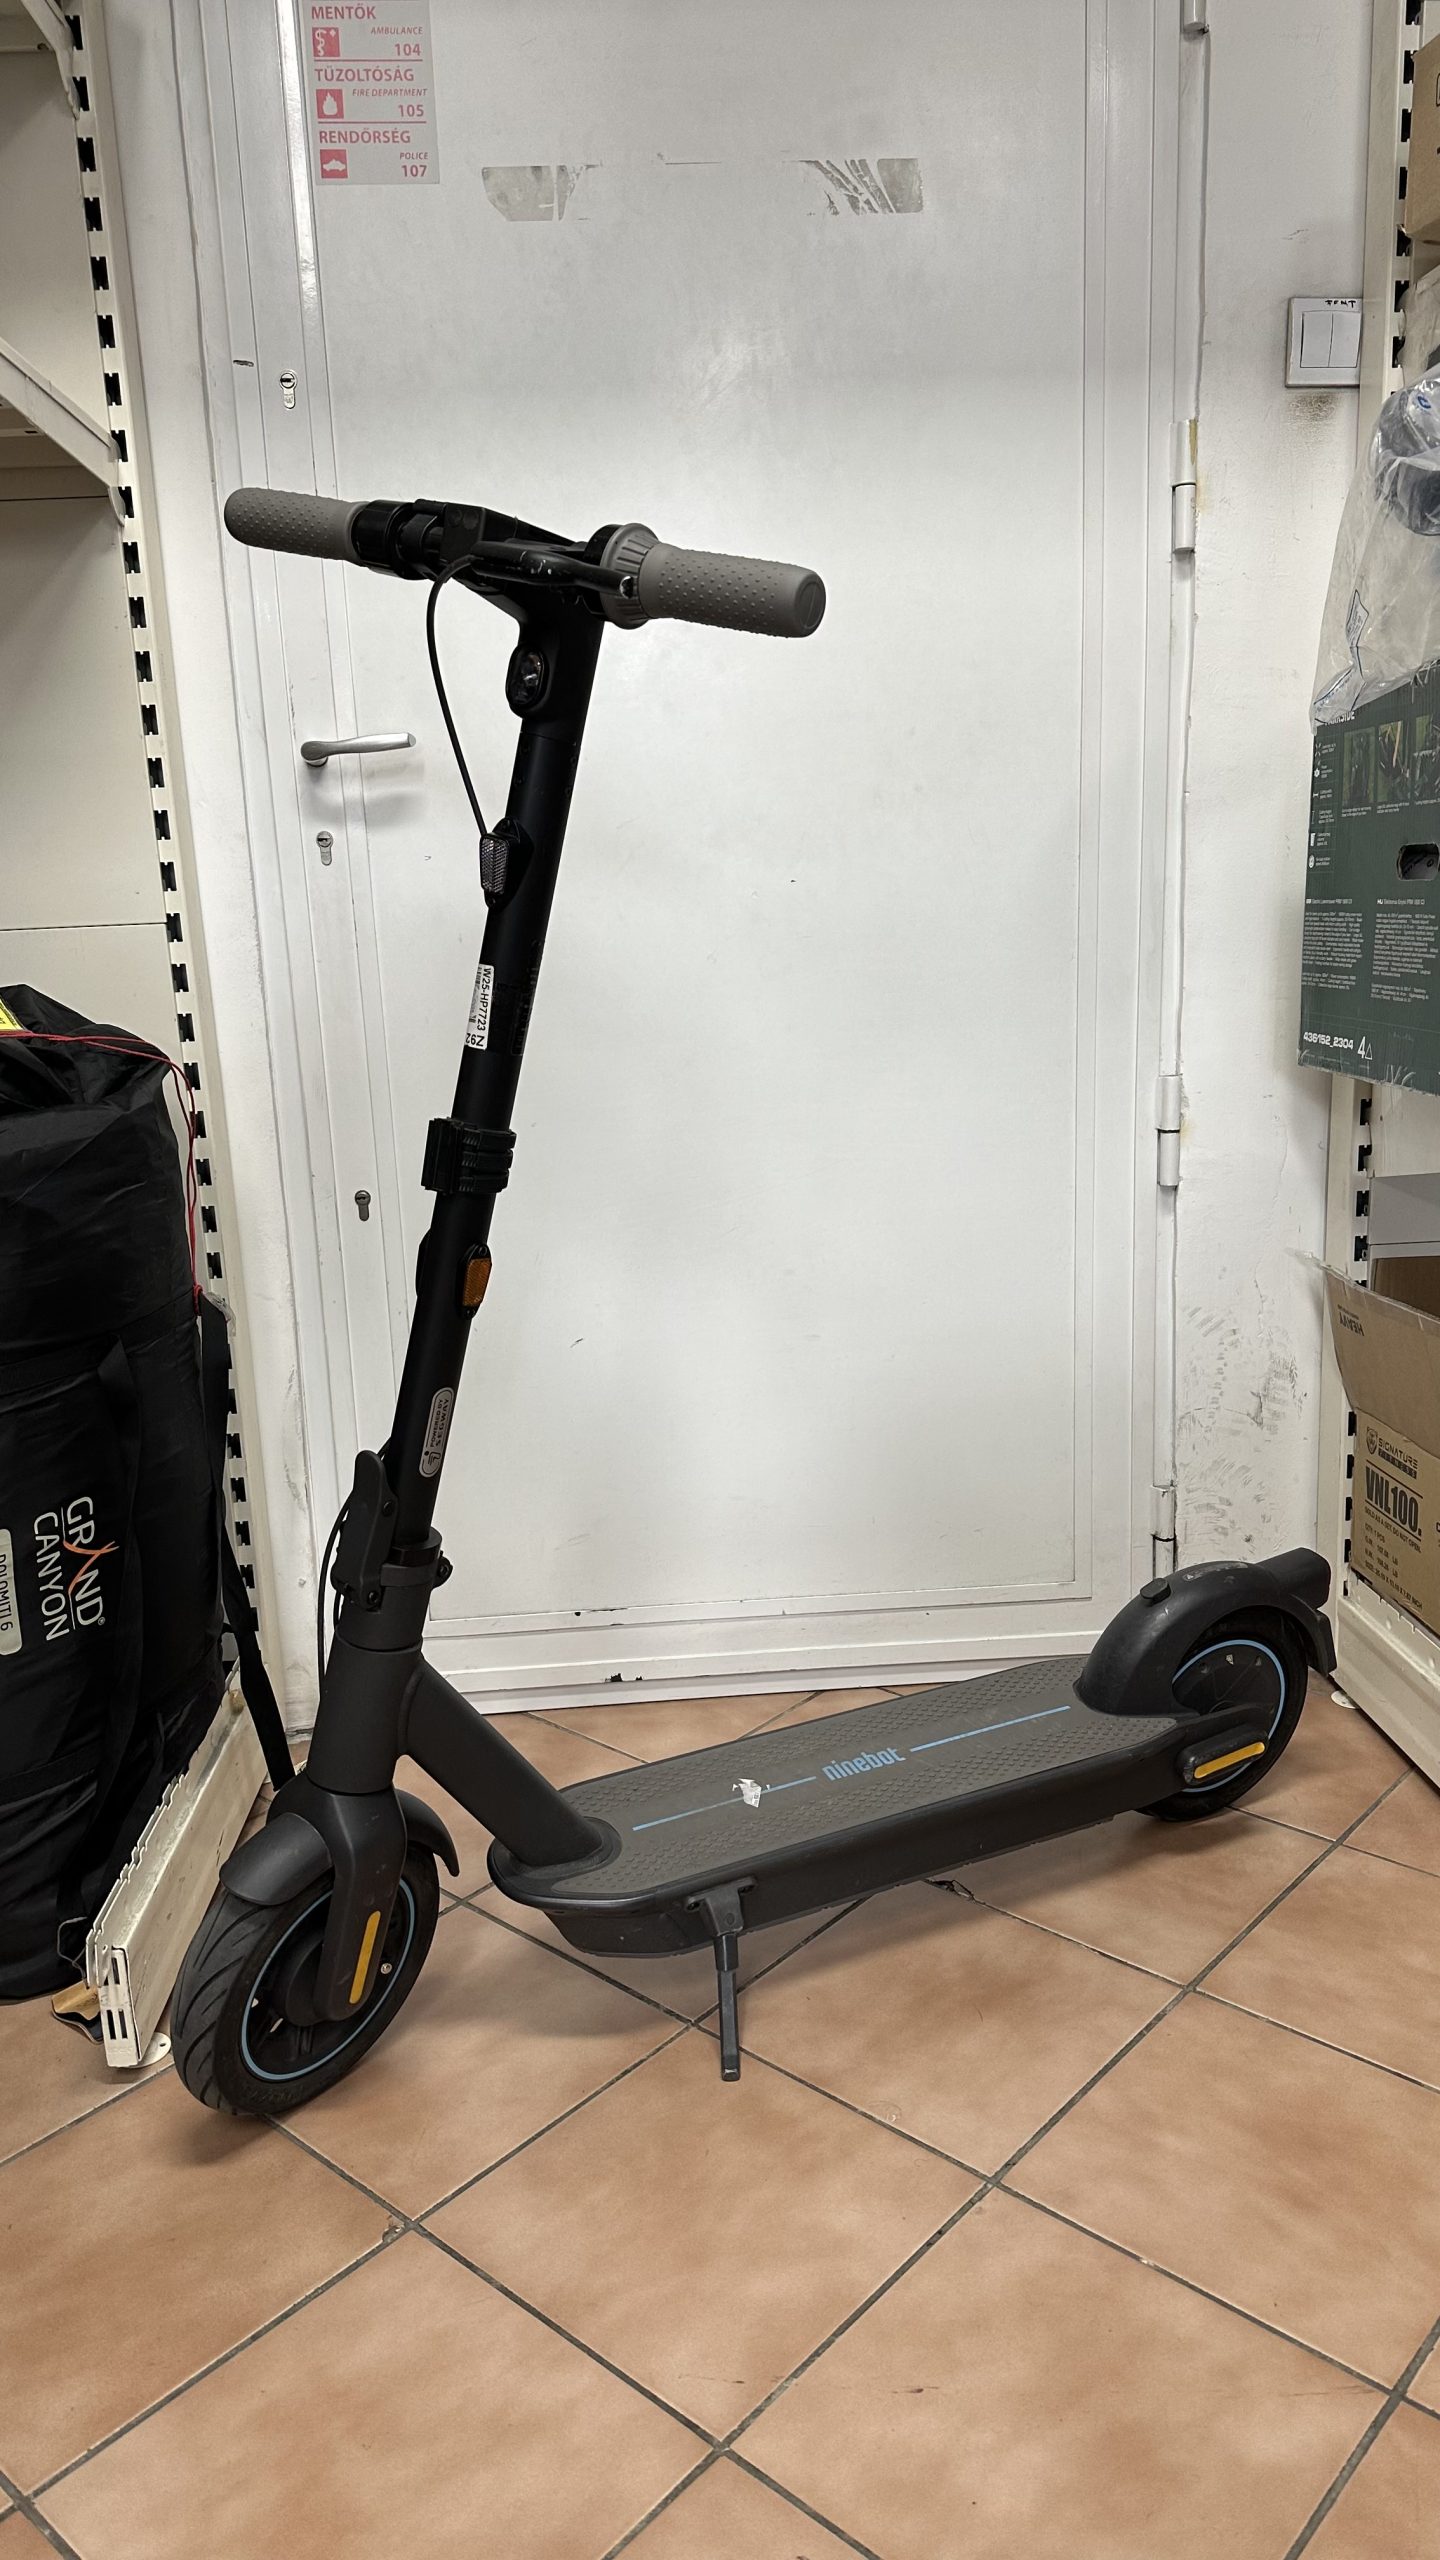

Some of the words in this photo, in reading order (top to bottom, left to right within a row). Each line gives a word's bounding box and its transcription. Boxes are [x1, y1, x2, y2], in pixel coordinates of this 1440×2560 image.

[312, 3, 376, 20] MENTŐK
[370, 27, 423, 35] AMBULANCE
[394, 43, 421, 56] 104
[314, 65, 414, 82] TŰZOLTÓSÁG
[352, 88, 370, 96] FIRE
[371, 88, 428, 96] DEPARTMENT
[398, 104, 424, 117] 105
[319, 127, 411, 144] RENDŐRSÉG
[400, 152, 428, 160] POLICE
[401, 165, 427, 177] 107
[477, 968, 491, 1031] W25-HP7723
[1303, 1031, 1354, 1050] 436152_2304
[1378, 1438, 1418, 1469] SIGNATURE
[65, 1496, 108, 1626] GRAND
[34, 1511, 70, 1641] CANYON
[0, 1621, 13, 1632] 6
[822, 1747, 906, 1781] ninebot
